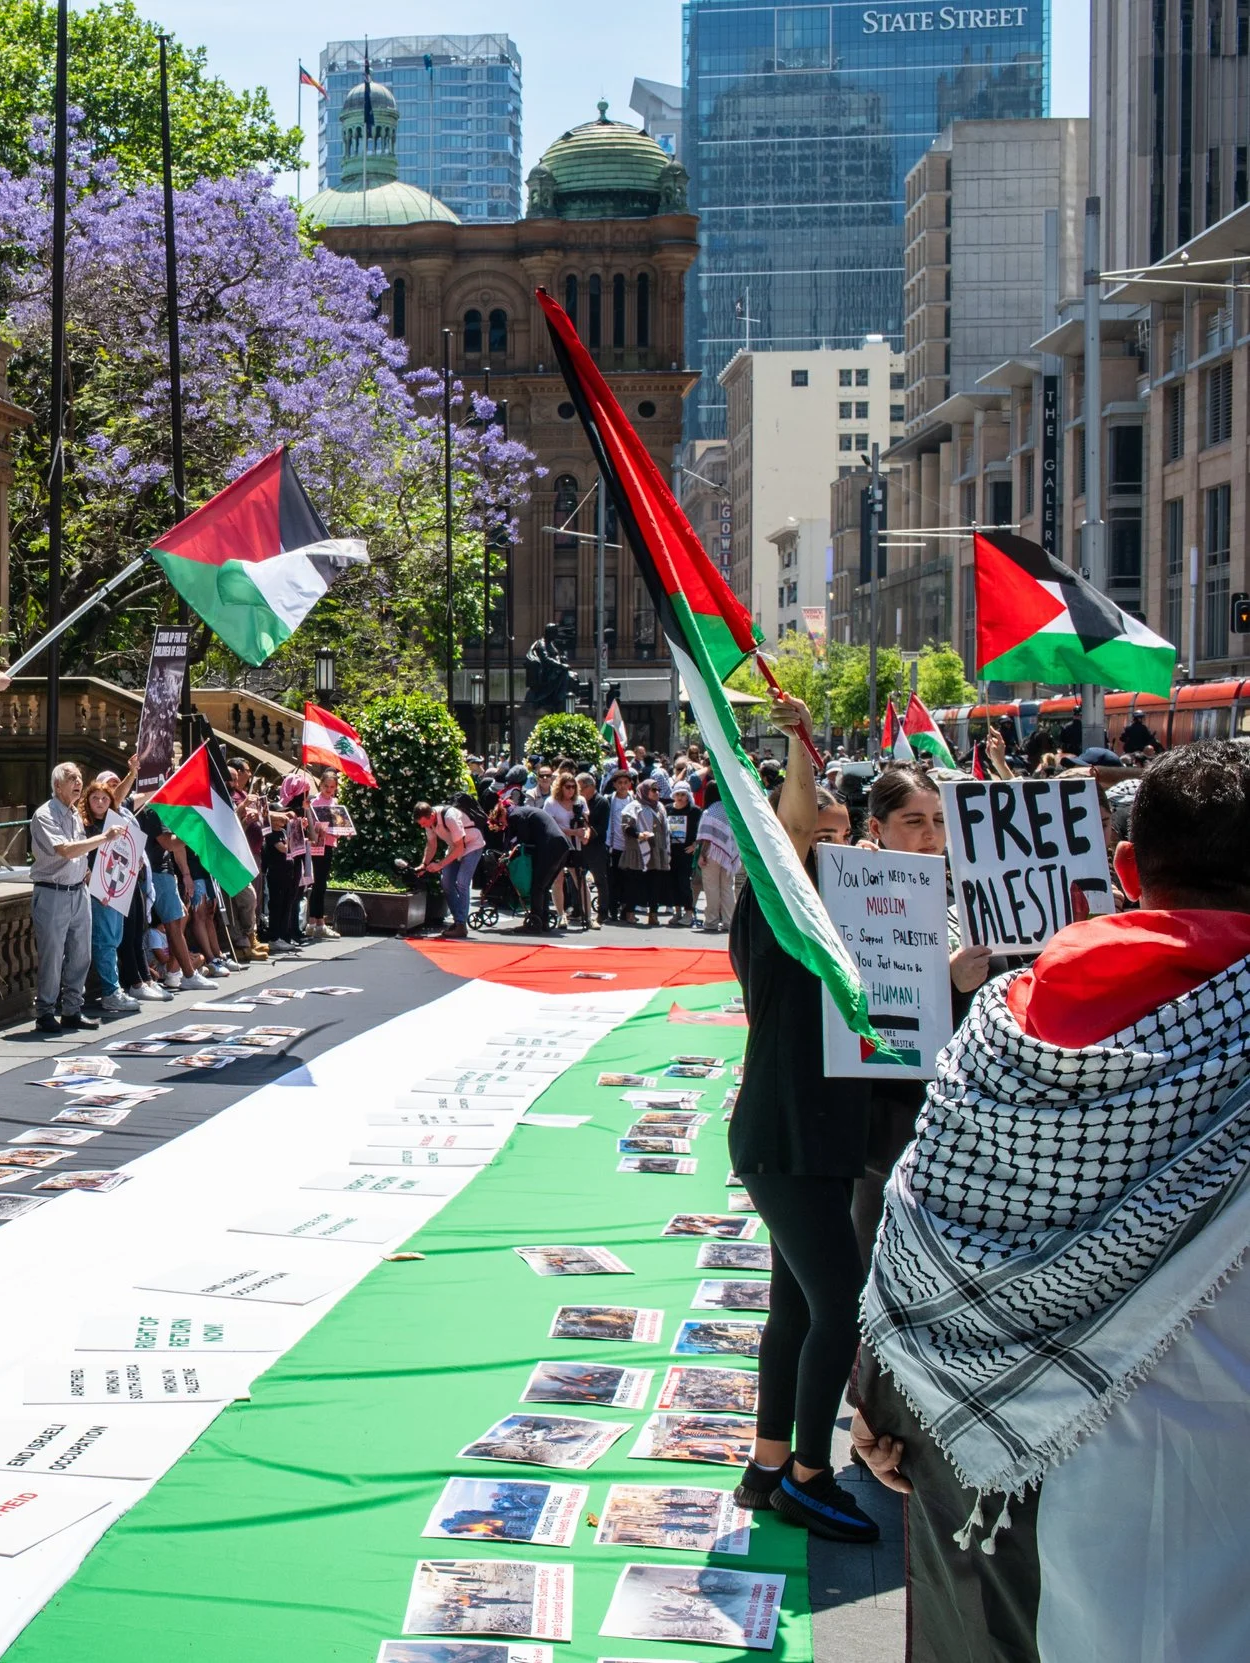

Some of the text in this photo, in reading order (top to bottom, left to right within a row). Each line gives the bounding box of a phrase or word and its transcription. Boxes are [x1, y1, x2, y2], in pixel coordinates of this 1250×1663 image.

[862, 6, 1028, 34] STATE STREET
[1045, 391, 1055, 437] THE
[956, 780, 1091, 864] FREE
[831, 853, 859, 888] You
[888, 869, 906, 883] NEED
[908, 873, 917, 884] To
[919, 872, 930, 886] Be
[866, 896, 906, 918] MUSLIM
[840, 924, 853, 941] To
[892, 928, 939, 947] PALESTINE
[855, 951, 872, 968] You
[877, 954, 891, 970] Just
[134, 1316, 159, 1349] RIGHT OF
[168, 1318, 192, 1347] RETURN
[203, 1323, 224, 1342] NOW!
[105, 1375, 120, 1395] WRONG
[164, 1375, 178, 1394] WRONG
[182, 1367, 200, 1394] PALESTINE
[6, 1423, 68, 1467] END ISRAELI
[48, 1425, 109, 1471] OCCUPATION
